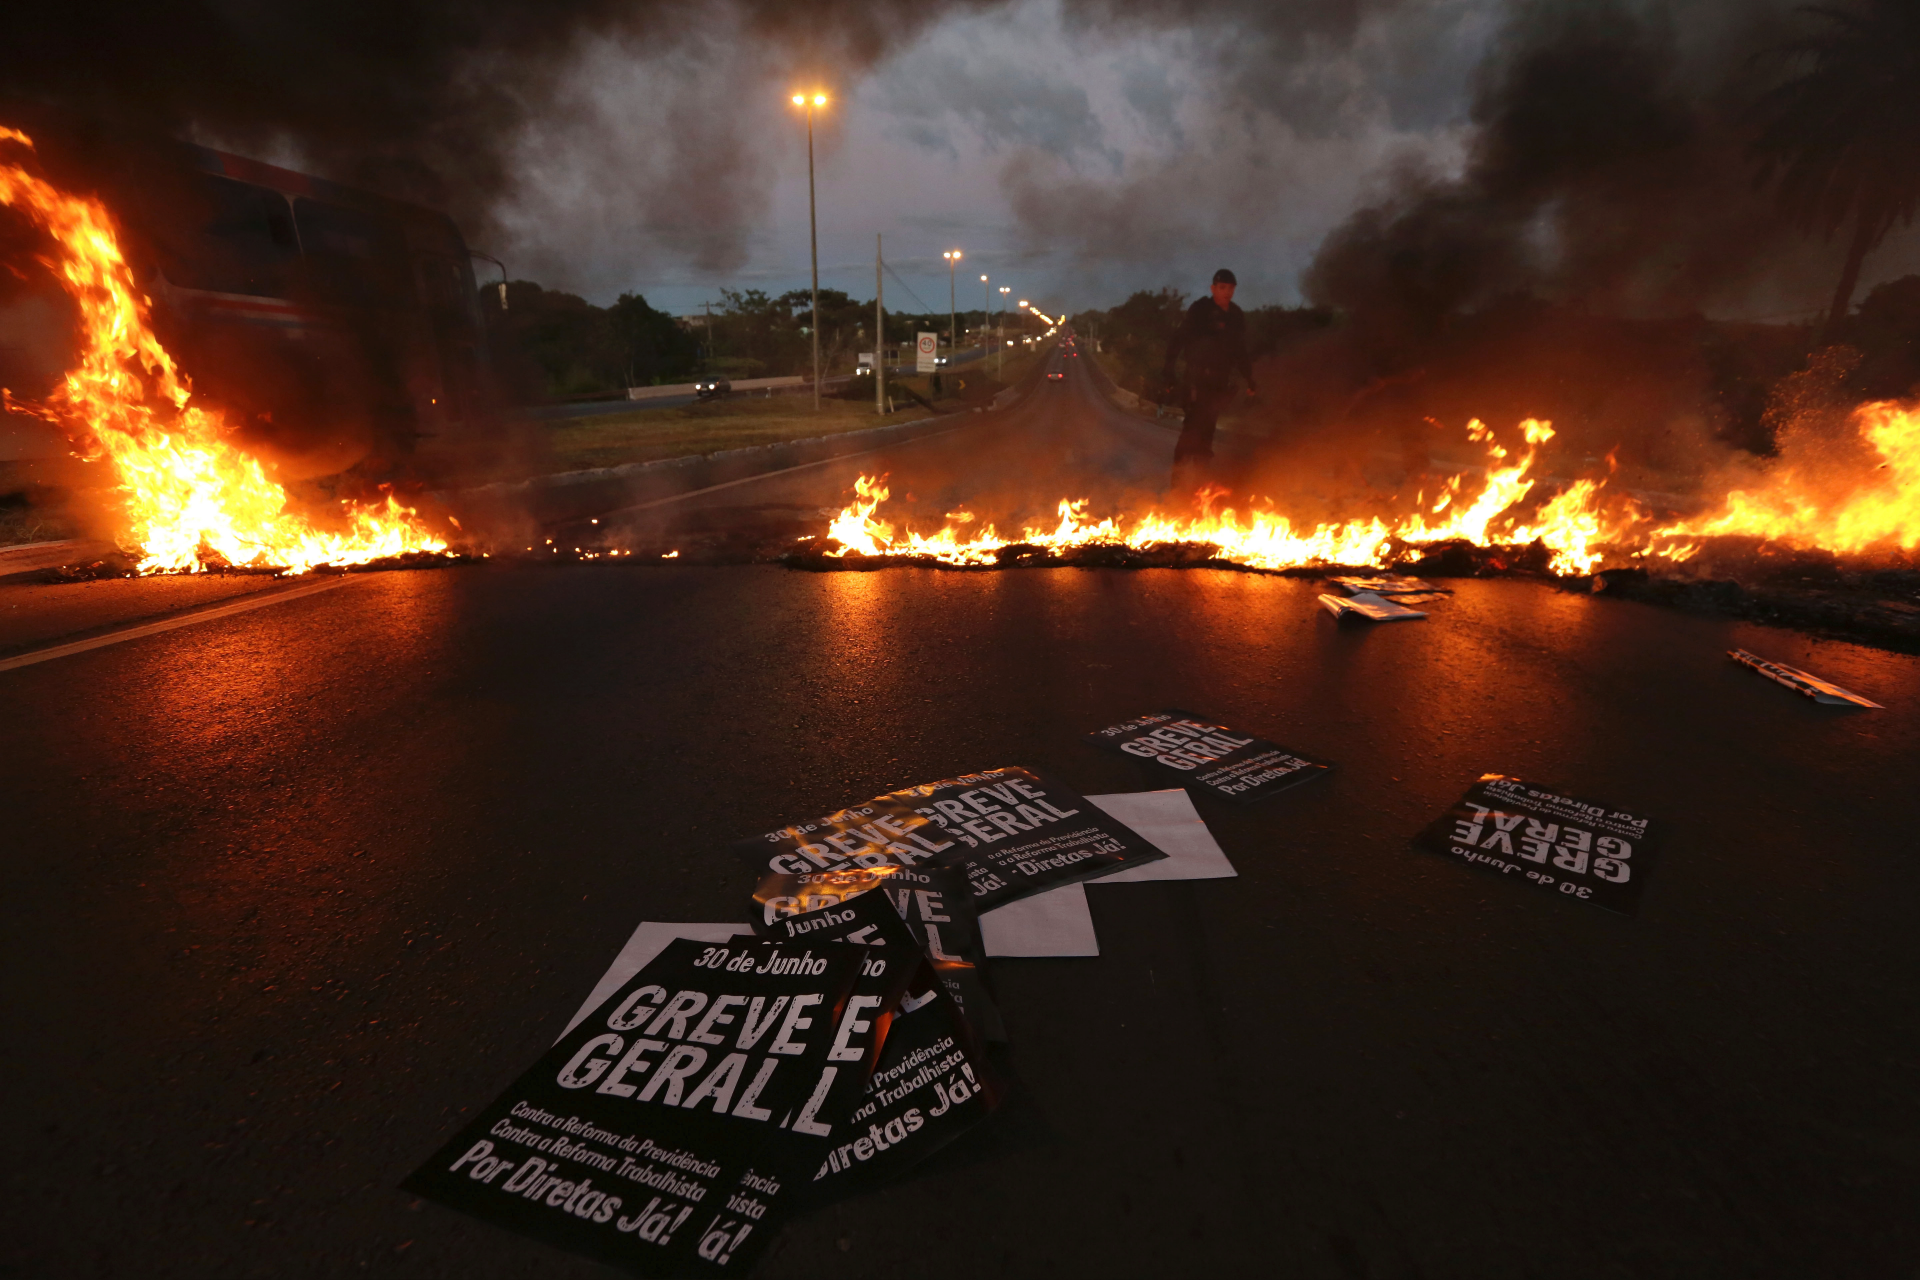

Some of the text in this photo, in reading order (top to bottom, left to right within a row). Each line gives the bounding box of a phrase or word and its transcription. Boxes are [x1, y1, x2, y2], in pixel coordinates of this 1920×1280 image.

[1101, 727, 1122, 737] 30
[1137, 714, 1172, 727] Junho
[1120, 719, 1217, 758] GREVE
[1157, 732, 1254, 771] GERAL
[957, 770, 1004, 784] Junho
[1206, 776, 1232, 786] Contra
[1217, 757, 1312, 795] Por Diretas Já!
[1483, 790, 1538, 811] Previdência
[1486, 785, 1542, 807] Trabalhista
[1489, 779, 1648, 828] Por Diretas Já!
[1546, 803, 1593, 821] Reforma
[765, 807, 874, 843] 30 de Junho
[1465, 802, 1632, 860] GERAL
[1553, 810, 1597, 827] Reforma
[1605, 820, 1645, 835] Contra
[1607, 825, 1642, 839] Contra
[769, 813, 919, 875] GREVE
[1000, 841, 1039, 856] Reforma
[1049, 826, 1100, 844] Previdência
[1015, 845, 1057, 861] Reforma
[1056, 832, 1110, 850] Trabalhista
[1016, 838, 1127, 876] Diretas Já!
[1450, 819, 1631, 884] GREVE
[797, 869, 931, 884] 30 de Junho
[970, 872, 1008, 897] Já!
[1450, 846, 1593, 899] 30 de Junho
[786, 909, 856, 938] Junho
[693, 947, 828, 976] 30 de Junho
[606, 985, 824, 1056] GREVE
[556, 1033, 780, 1122] GERAL
[873, 1036, 954, 1090] Previdência
[875, 1050, 965, 1109] Trabalhista
[929, 1062, 982, 1118] Já!
[510, 1100, 721, 1179] Contra a Reforma da Previdência
[490, 1118, 707, 1202] Contra a Reforma Trabalhista
[449, 1139, 694, 1246] Por Diretas Já!
